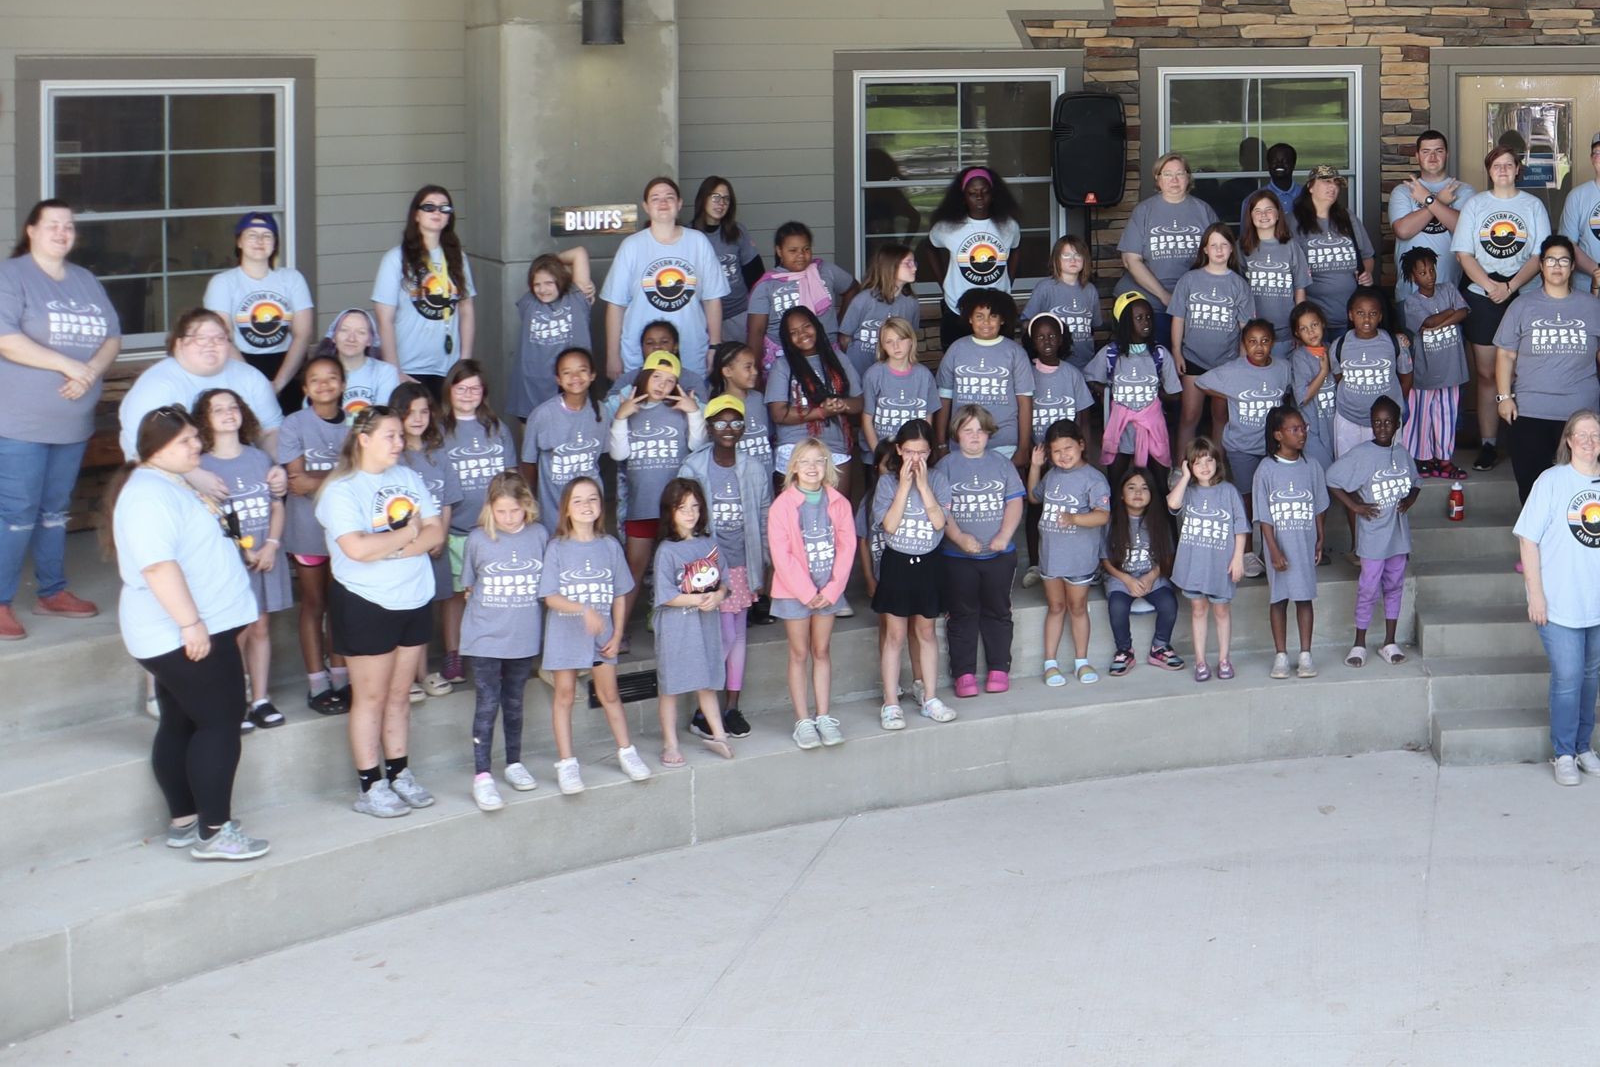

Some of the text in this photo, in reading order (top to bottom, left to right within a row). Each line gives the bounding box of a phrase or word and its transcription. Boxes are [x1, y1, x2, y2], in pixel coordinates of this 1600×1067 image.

[565, 210, 622, 230] BLUFFS
[1250, 279, 1292, 288] FFECT
[459, 467, 504, 479] FFECT
[567, 594, 613, 604] FFECT
